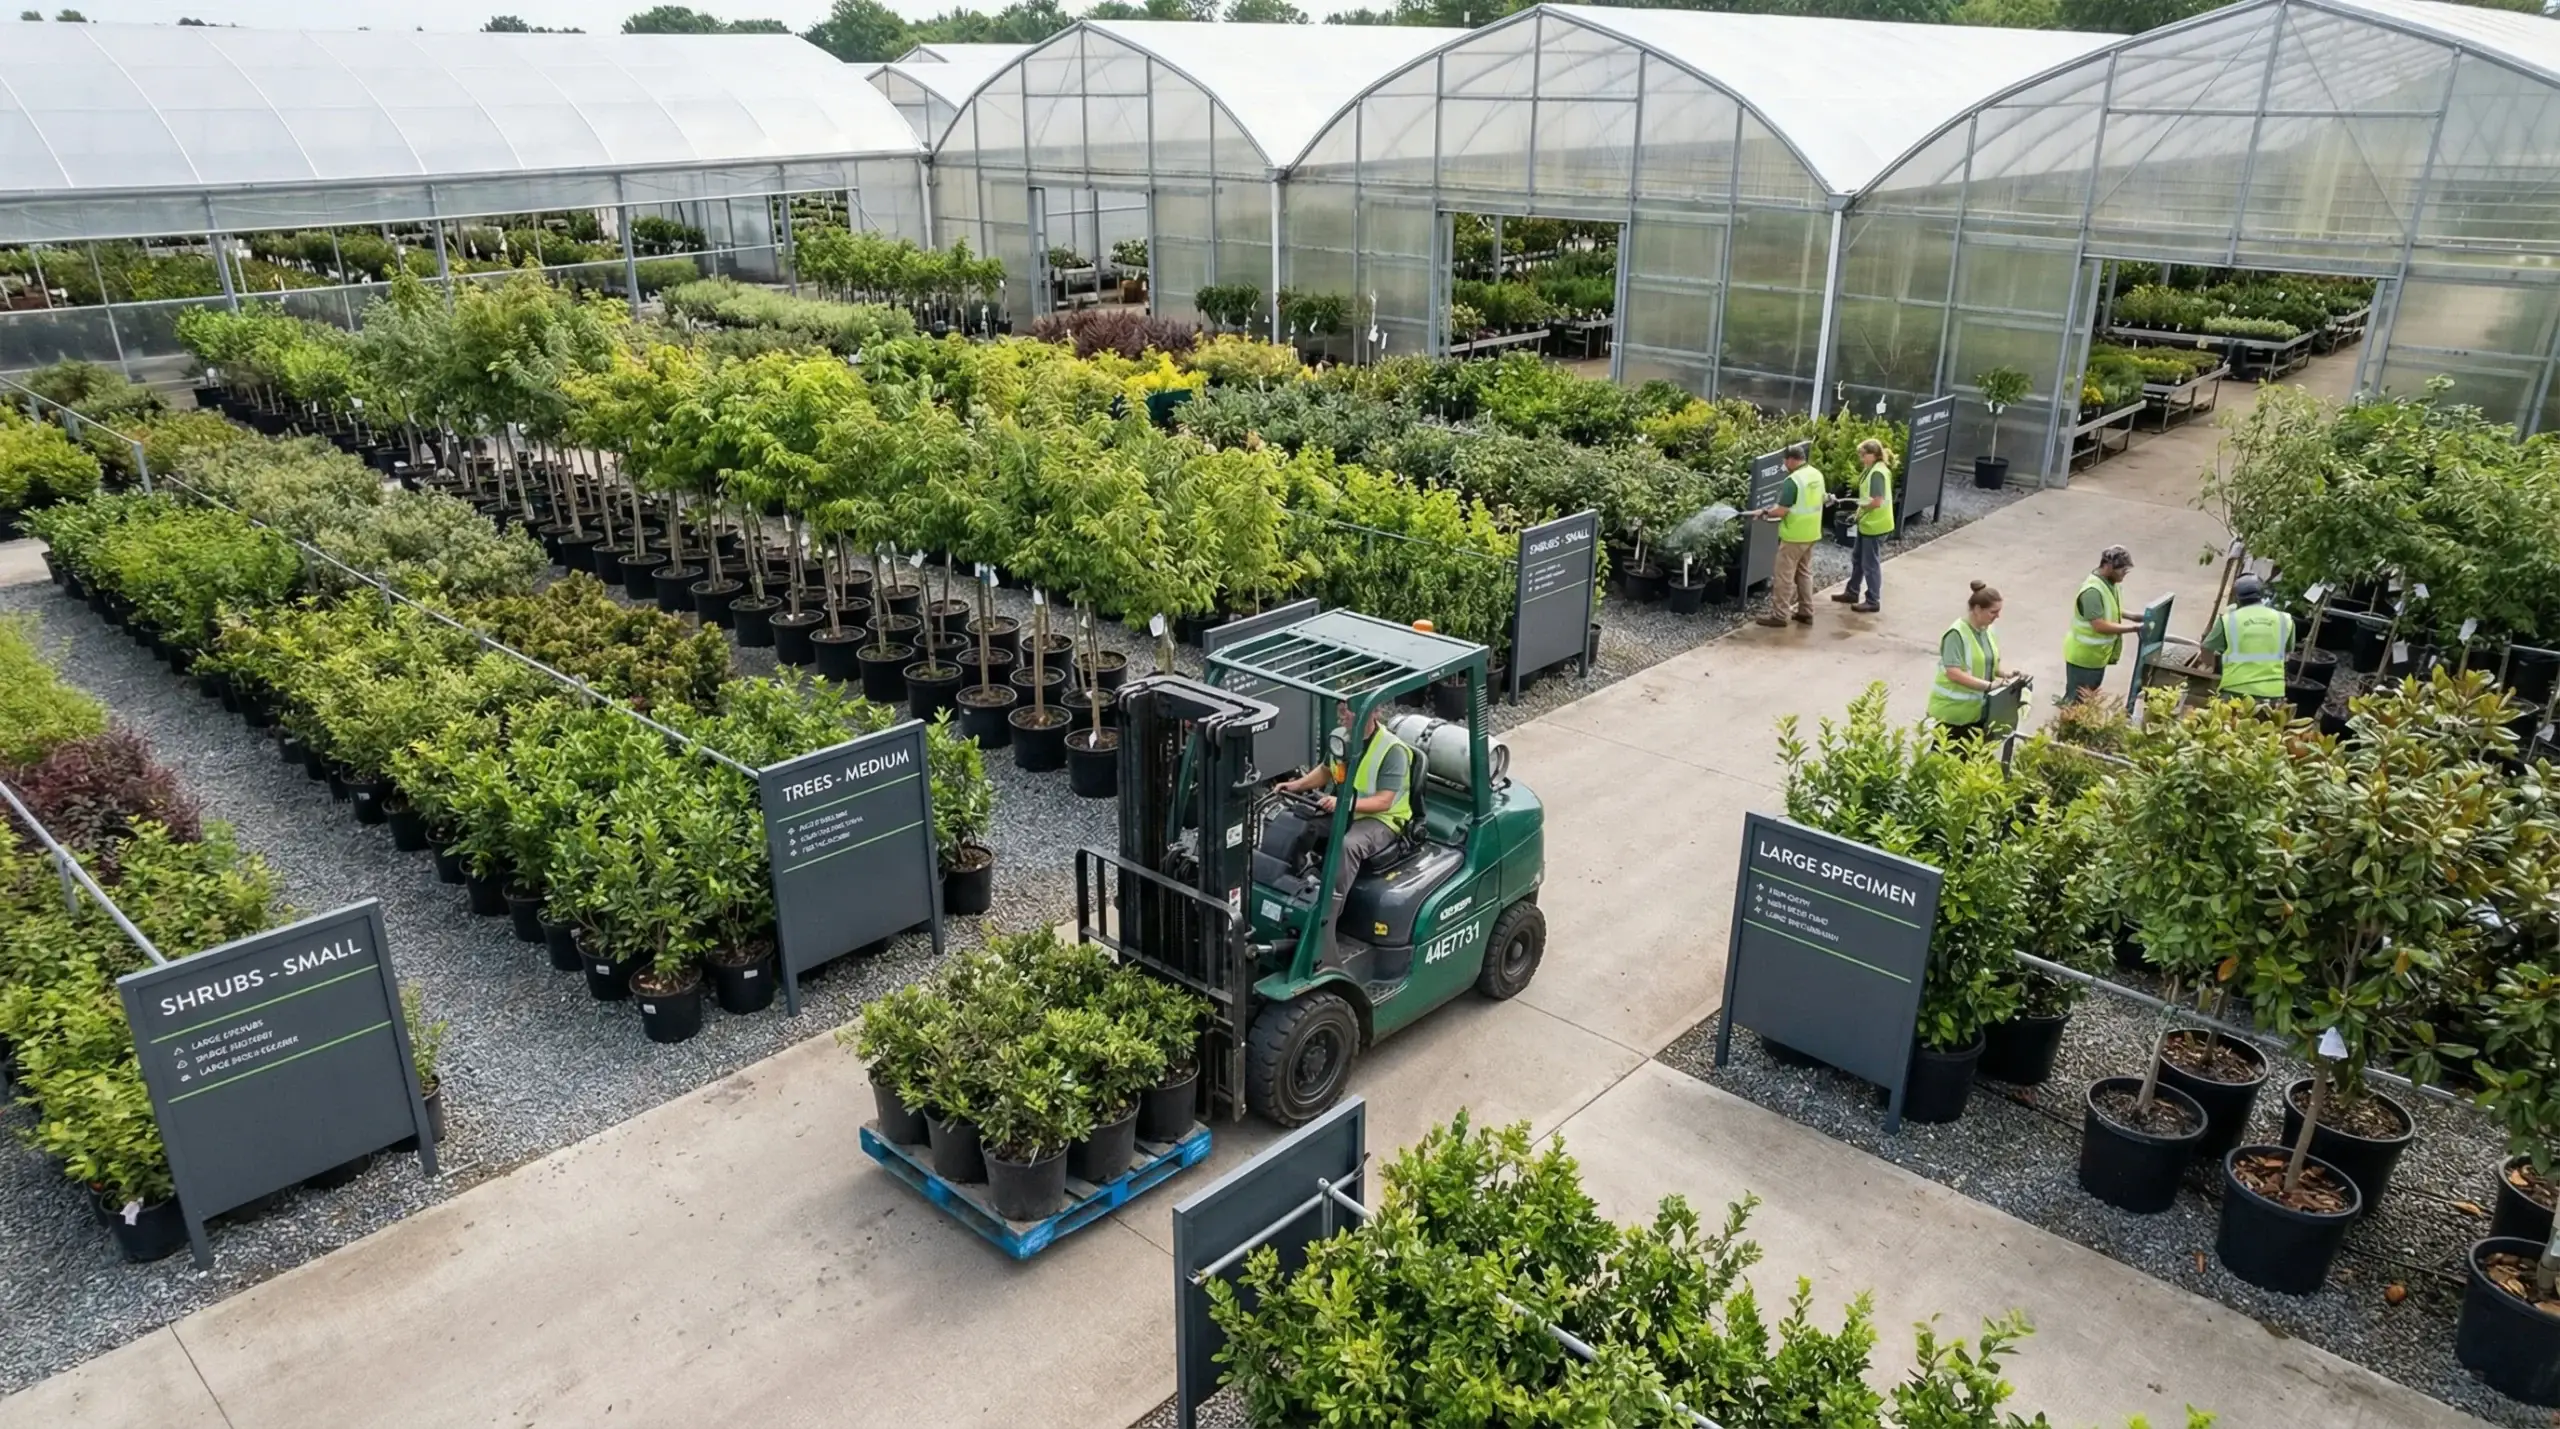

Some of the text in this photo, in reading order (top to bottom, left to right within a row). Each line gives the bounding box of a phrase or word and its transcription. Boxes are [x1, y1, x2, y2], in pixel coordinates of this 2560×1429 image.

[782, 774, 833, 802] TREES
[845, 749, 910, 782] MEDIUM
[1759, 840, 1818, 874] LARGE
[1820, 862, 1916, 907] SPECIMEN
[1425, 921, 1480, 965] 44E7731
[160, 969, 264, 1016] SHRUBS
[282, 938, 362, 976] SMALL
